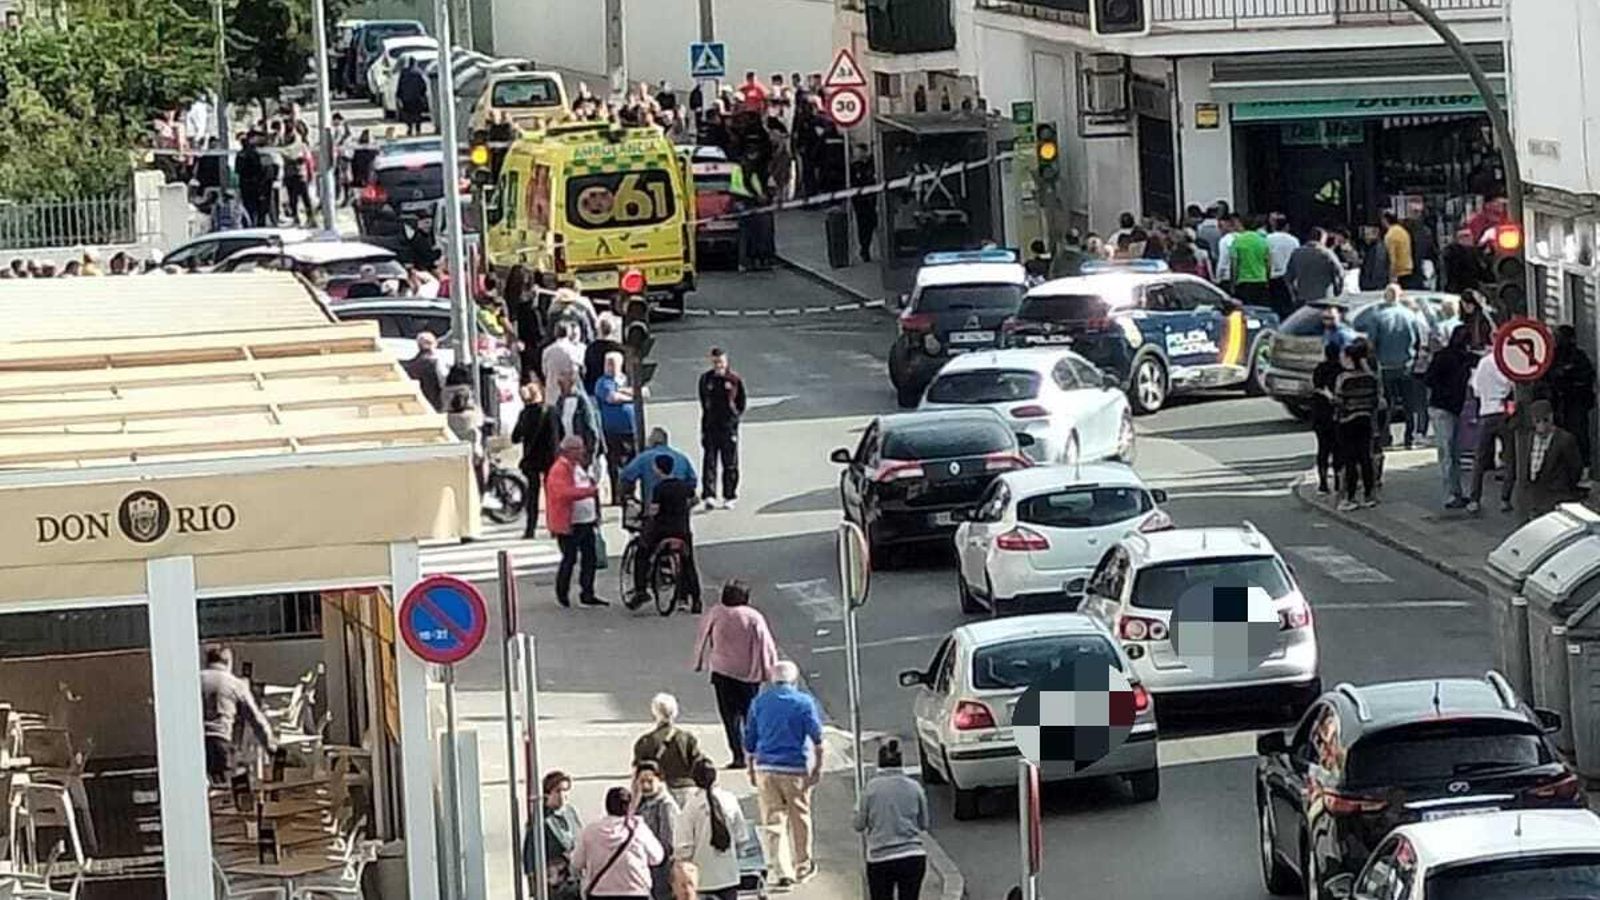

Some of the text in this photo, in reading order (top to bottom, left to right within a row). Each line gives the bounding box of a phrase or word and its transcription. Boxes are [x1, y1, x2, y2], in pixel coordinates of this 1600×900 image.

[835, 100, 856, 113] 30
[36, 503, 236, 543] DON RIO
